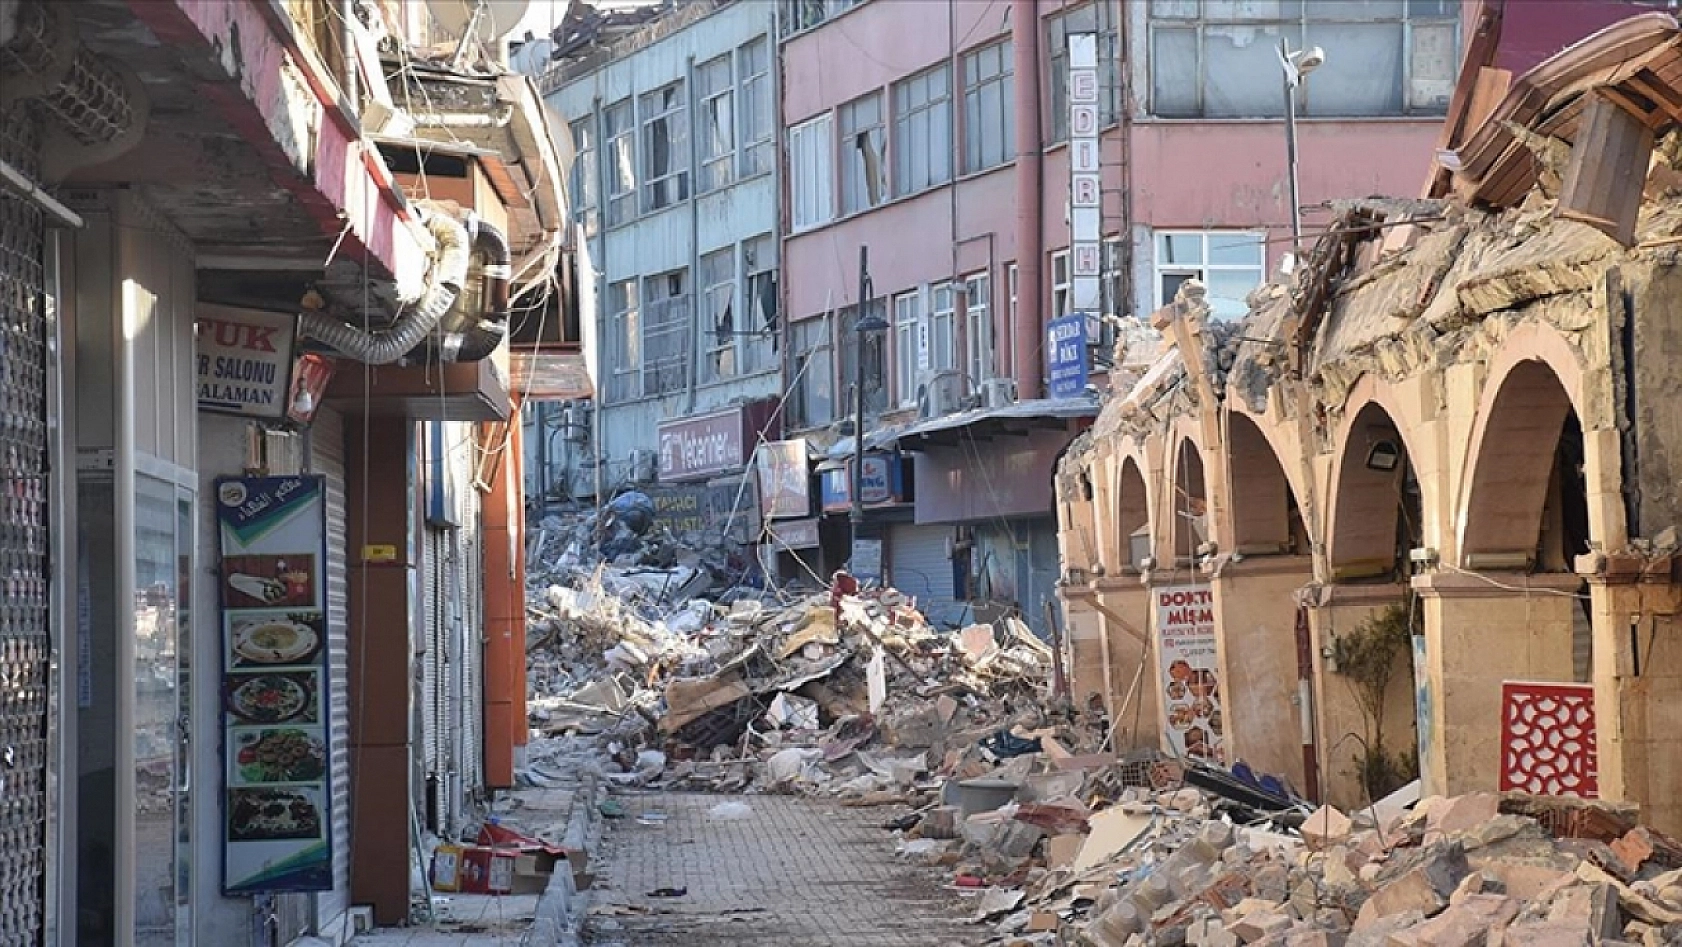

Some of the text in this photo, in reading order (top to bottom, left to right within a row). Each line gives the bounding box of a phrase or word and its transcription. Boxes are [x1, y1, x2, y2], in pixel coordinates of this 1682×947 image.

[214, 355, 277, 386] SALONU
[198, 383, 276, 405] ALAMAN
[681, 424, 729, 471] Veteriner
